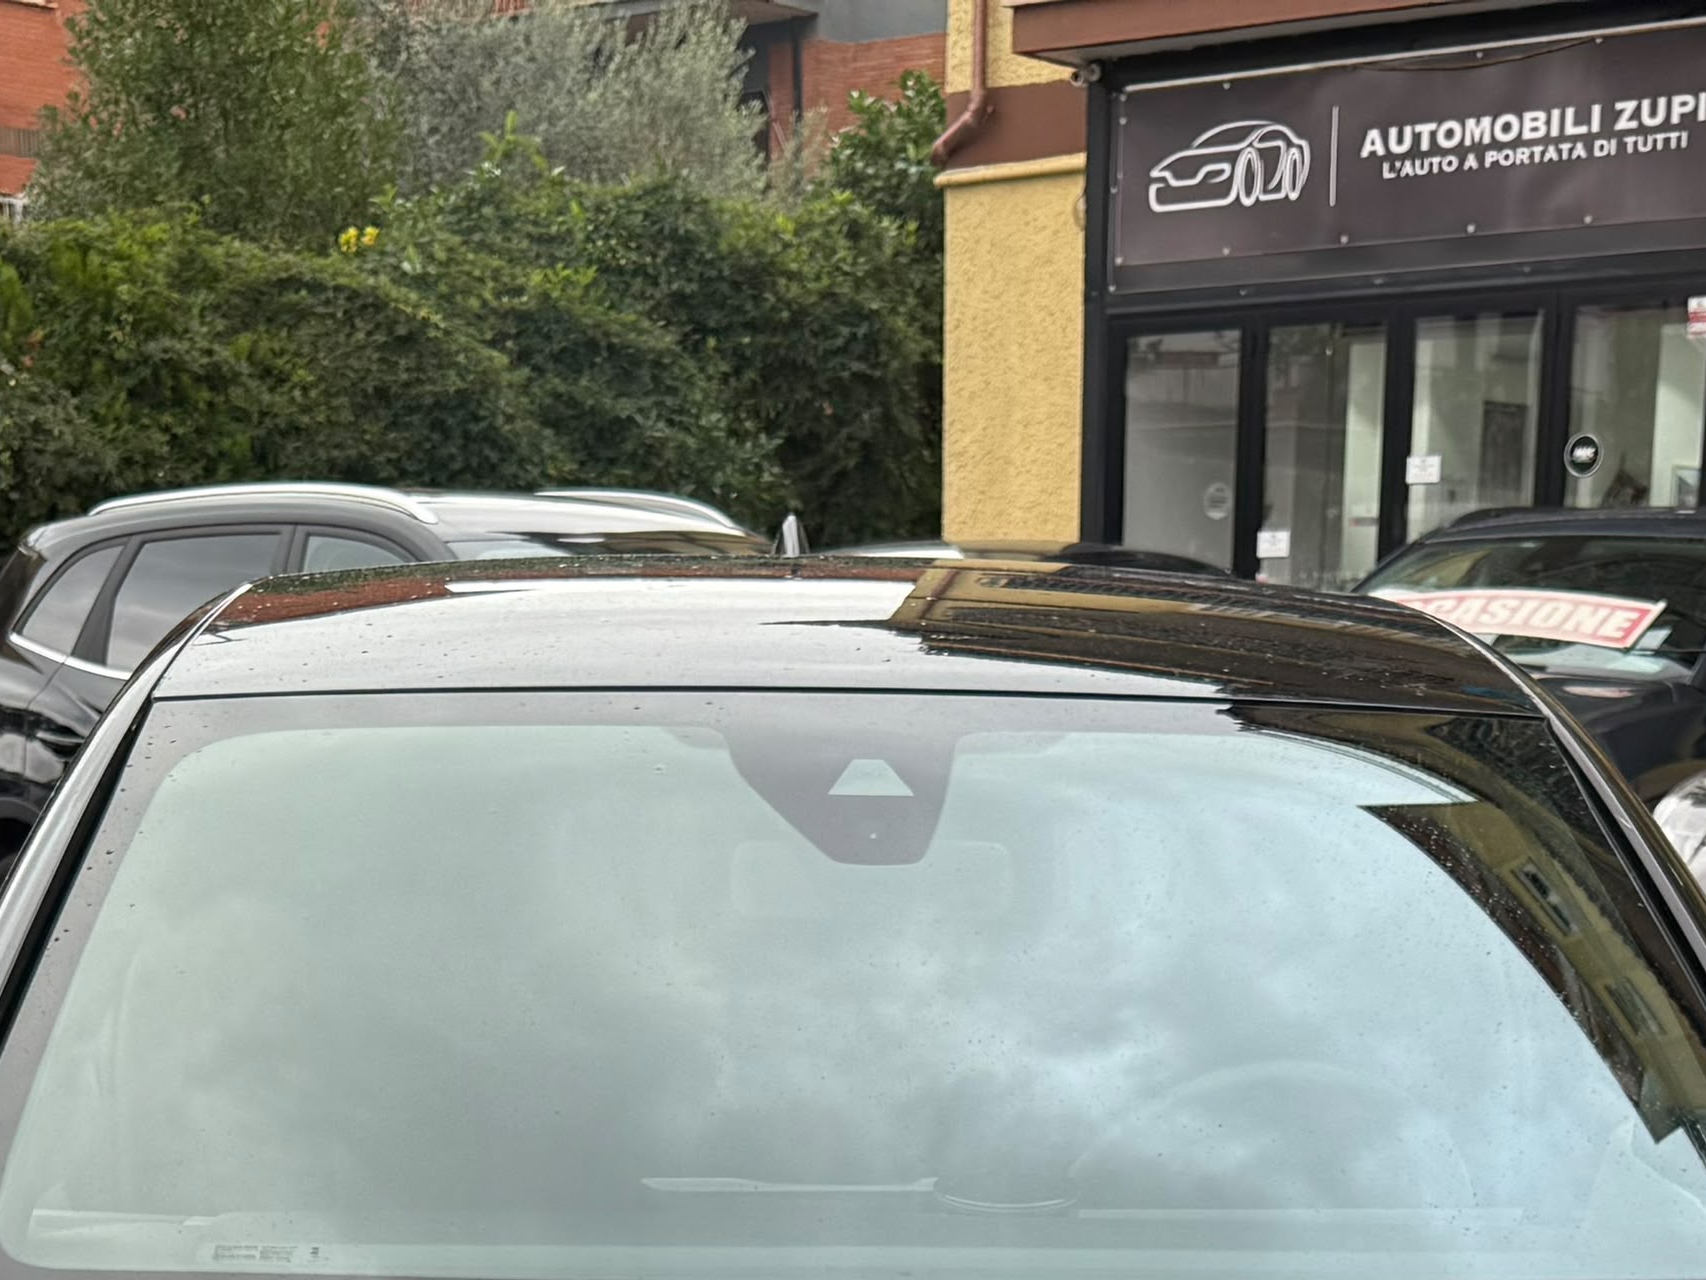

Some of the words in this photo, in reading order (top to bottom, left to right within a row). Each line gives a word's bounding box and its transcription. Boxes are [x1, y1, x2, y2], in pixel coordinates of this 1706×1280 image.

[1360, 103, 1602, 158] AUTOMOBILI
[1382, 154, 1459, 180] L'AUTO
[1463, 153, 1479, 171] A
[1484, 142, 1587, 168] PORTATA
[1594, 138, 1617, 158] DI
[1623, 131, 1689, 154] TUTTI
[1425, 596, 1641, 639] CASIONE
